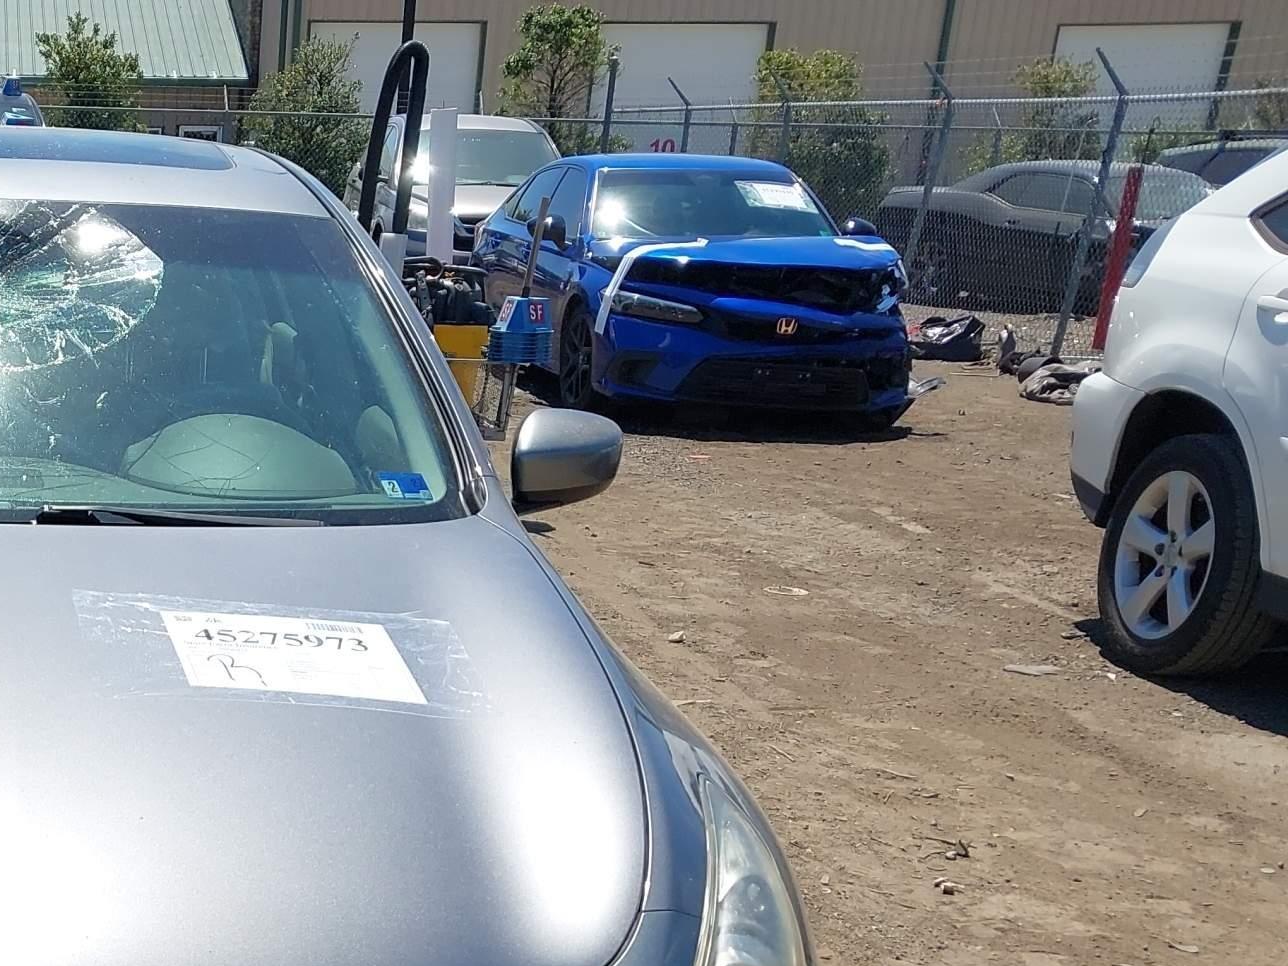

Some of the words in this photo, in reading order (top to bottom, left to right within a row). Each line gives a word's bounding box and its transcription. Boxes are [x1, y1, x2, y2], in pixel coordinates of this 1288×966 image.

[650, 138, 675, 153] 10
[529, 304, 543, 321] SF
[195, 628, 369, 653] 45275973
